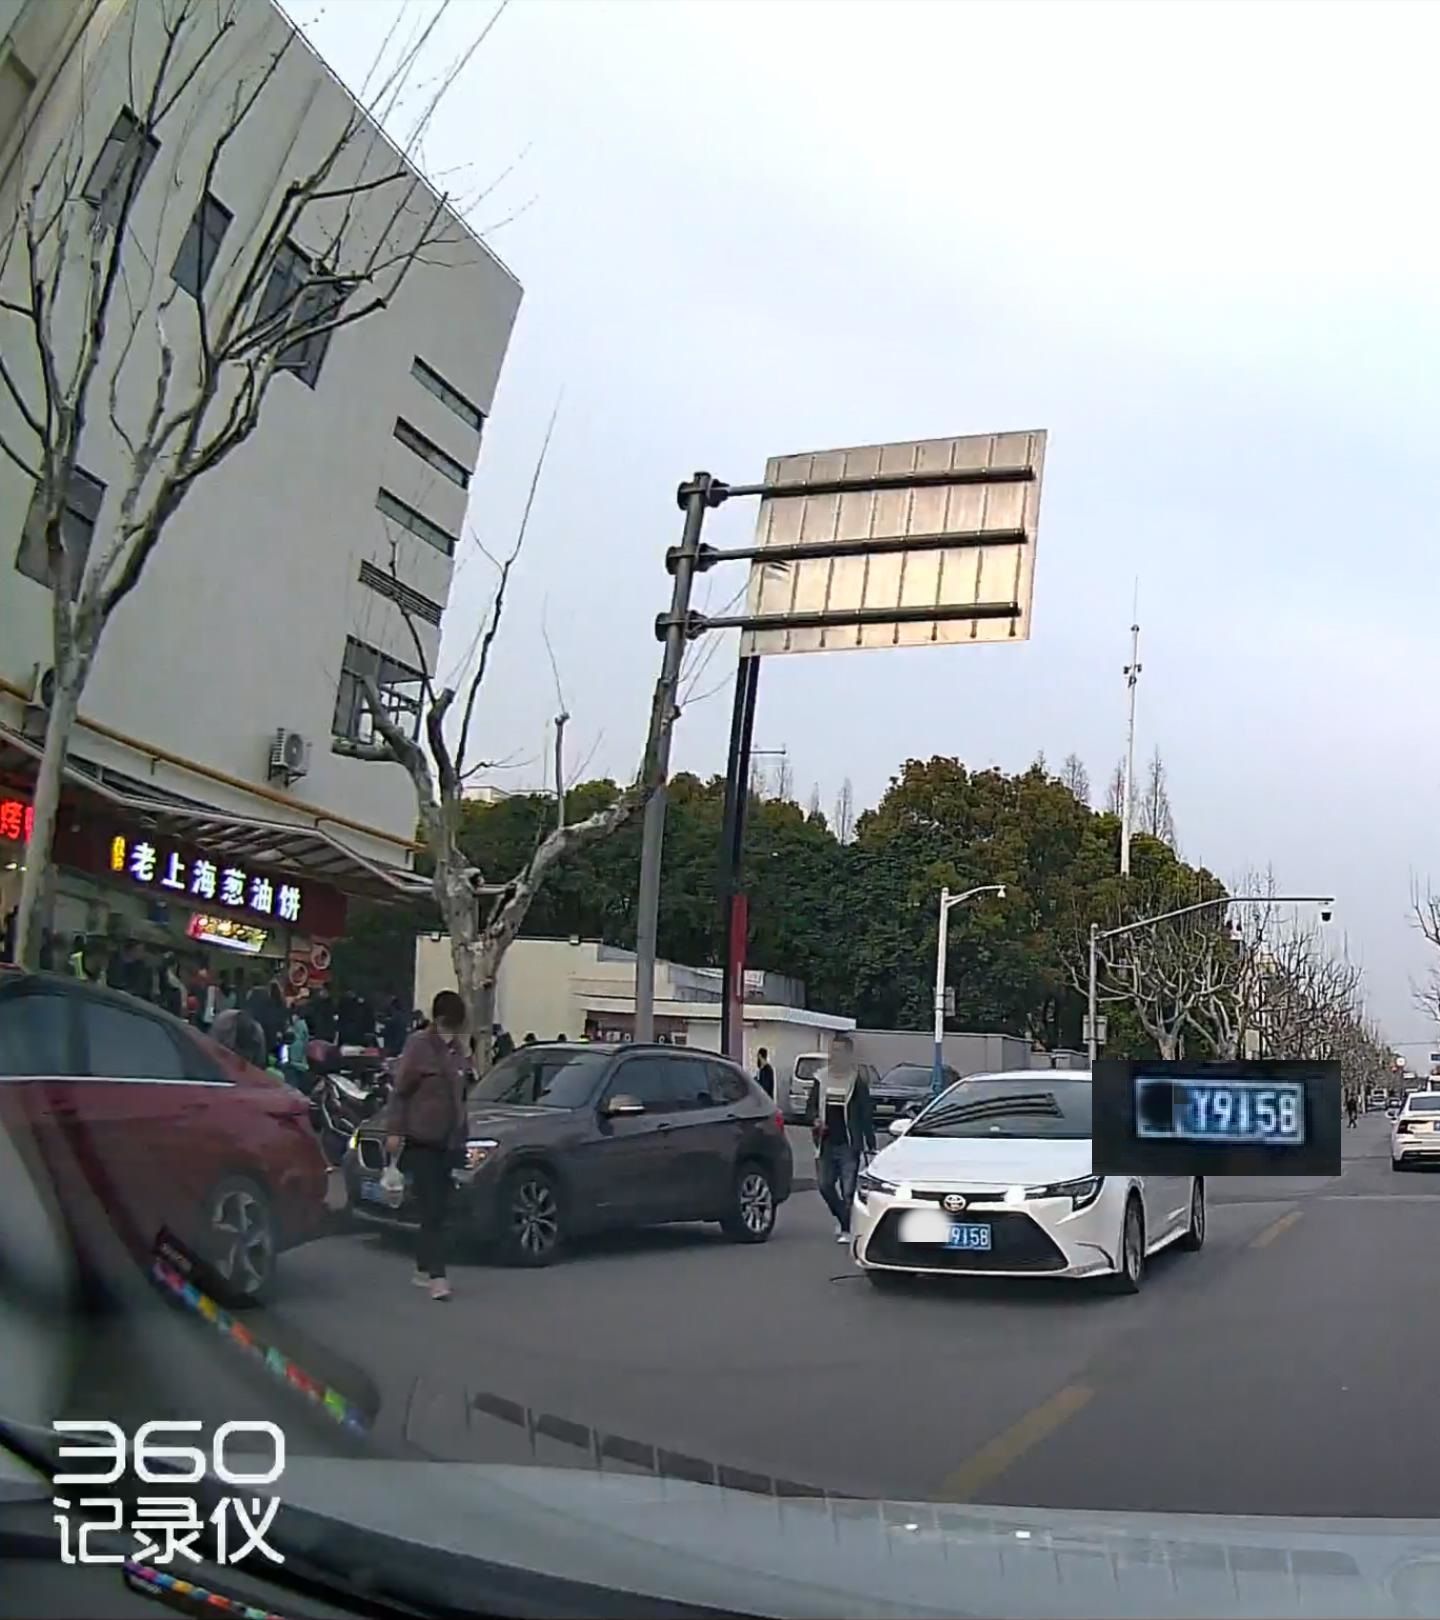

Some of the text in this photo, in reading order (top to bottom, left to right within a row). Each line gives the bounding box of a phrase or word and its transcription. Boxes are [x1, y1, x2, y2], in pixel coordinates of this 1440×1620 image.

[131, 842, 301, 921] 老上海葱油饼
